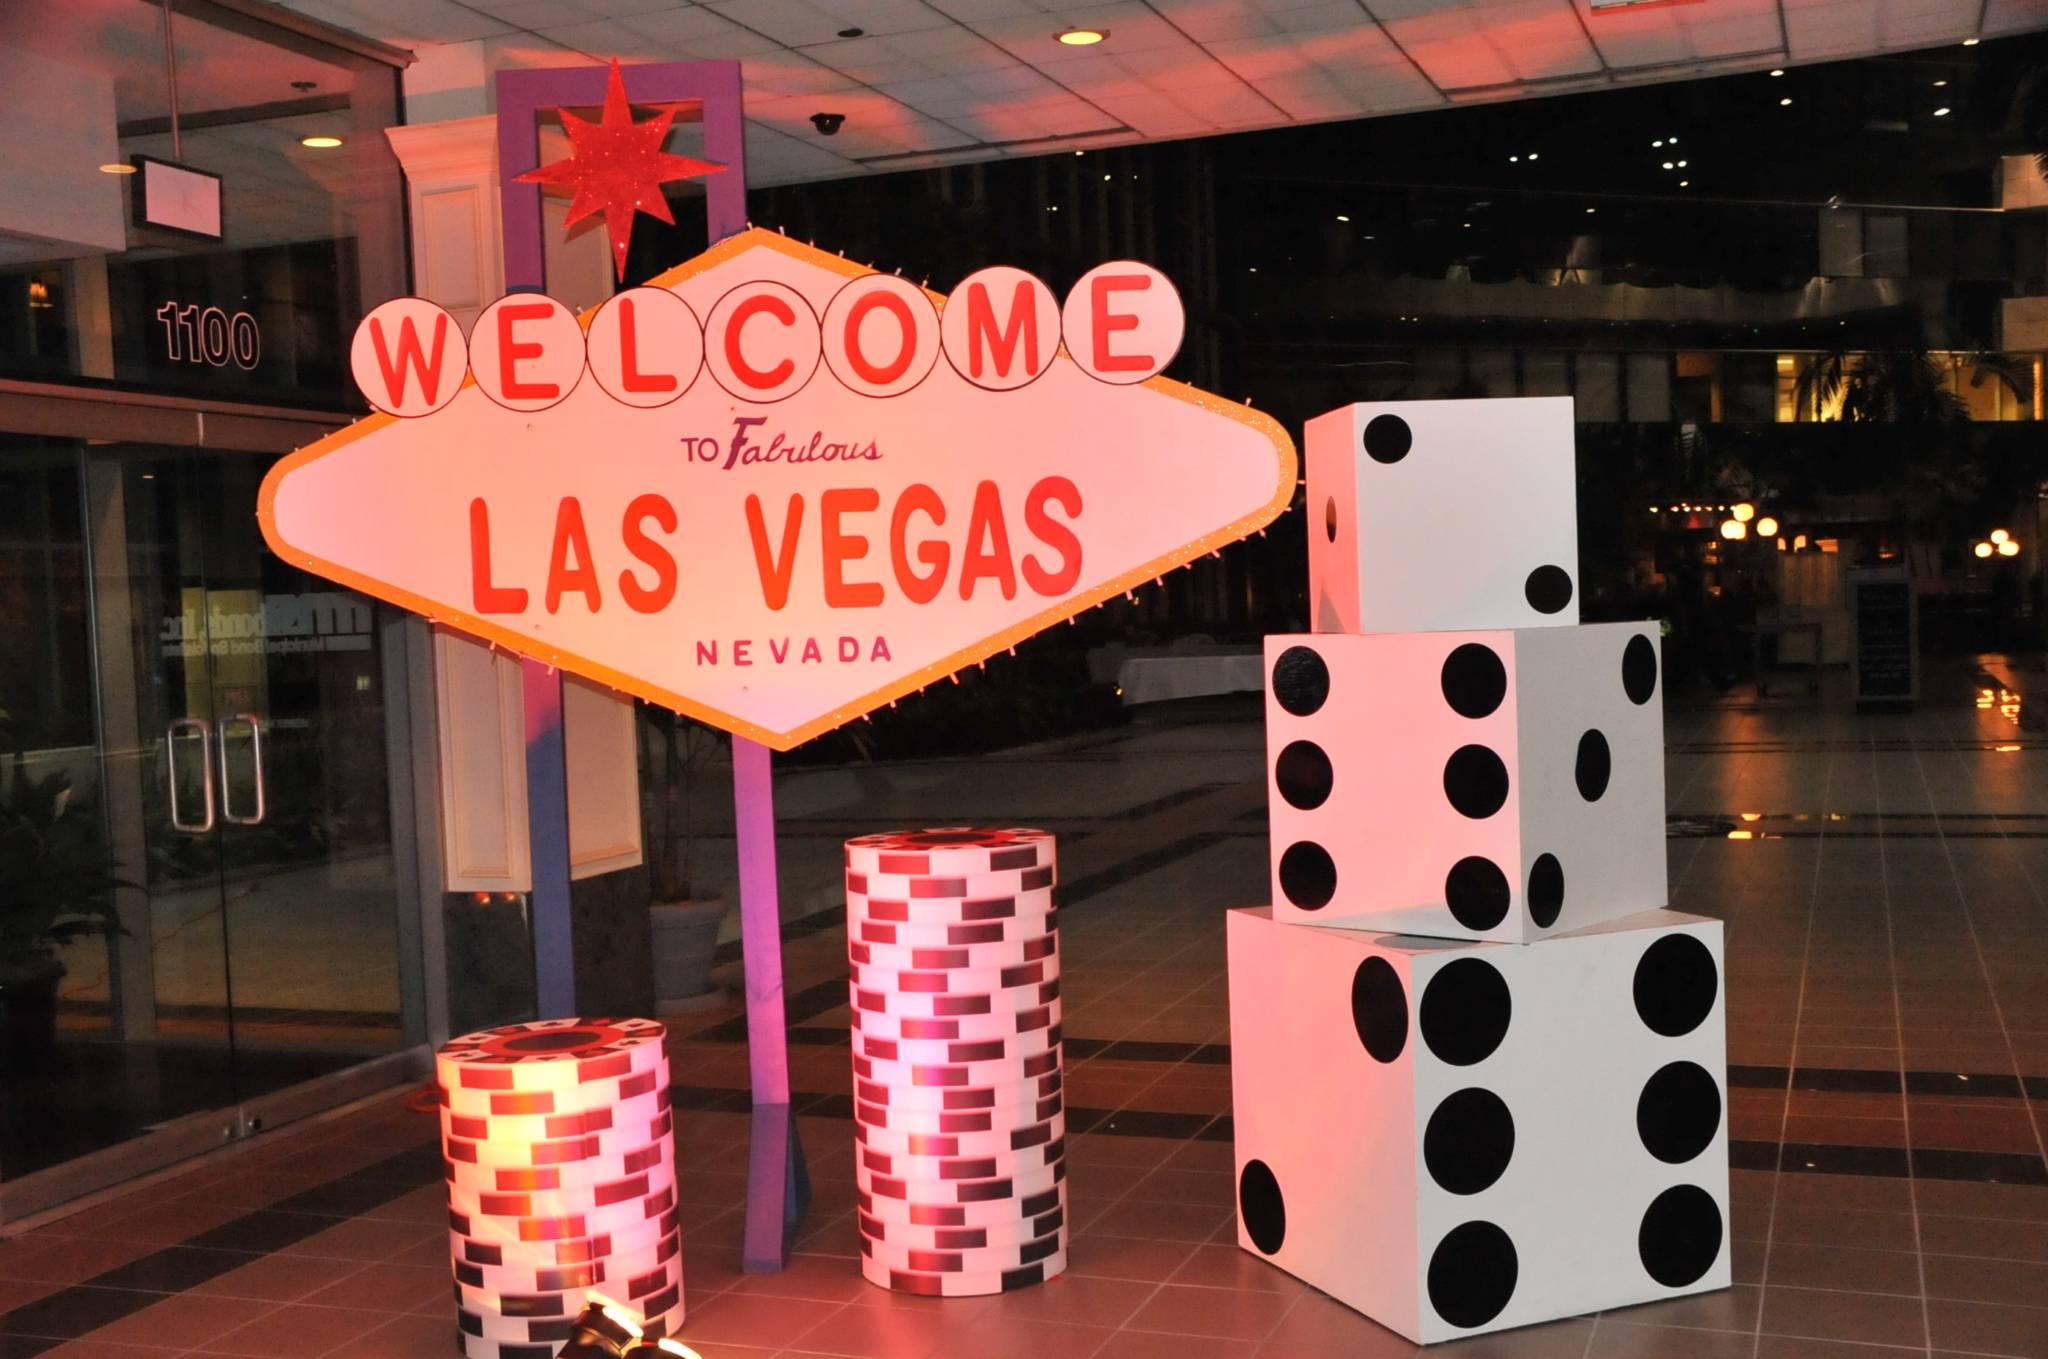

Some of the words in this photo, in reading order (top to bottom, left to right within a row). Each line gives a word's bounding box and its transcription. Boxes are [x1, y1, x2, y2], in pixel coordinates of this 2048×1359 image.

[156, 301, 261, 371] 1100
[368, 273, 1156, 410] WELCOME
[680, 437, 720, 463] TO
[721, 416, 884, 471] Fabulous
[469, 493, 679, 615] LAS
[744, 475, 1084, 612] VEGAS
[696, 636, 893, 667] NEVADA
